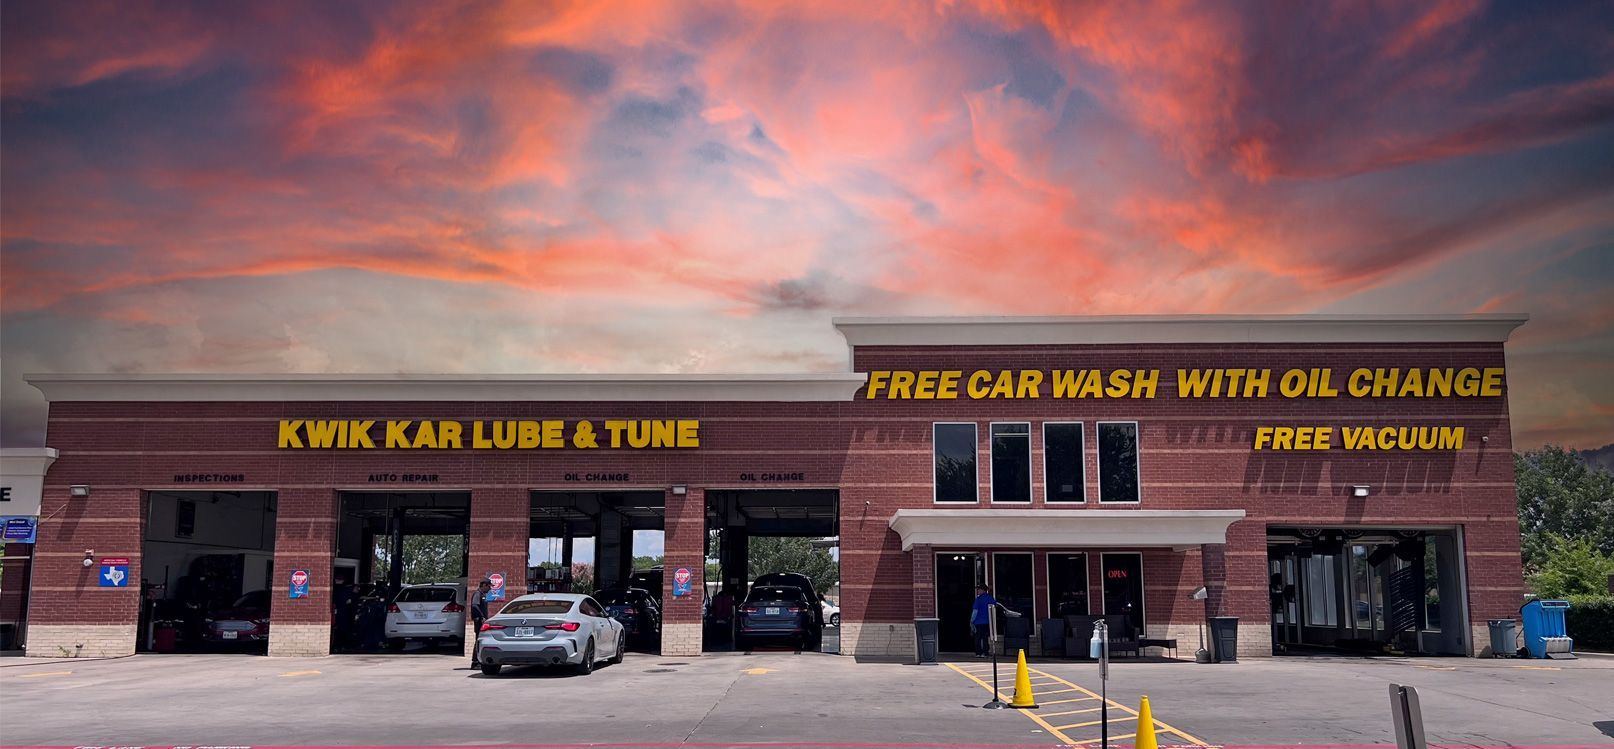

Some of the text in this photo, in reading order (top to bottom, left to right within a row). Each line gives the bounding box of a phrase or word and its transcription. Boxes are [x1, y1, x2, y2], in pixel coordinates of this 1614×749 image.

[866, 367, 1504, 400] FREE CAR WASH WITH OIL CHANGE
[278, 419, 700, 449] KWIK KAR LUBE & TUNE
[1254, 426, 1465, 450] FREE VACUUM
[173, 473, 245, 483] INSPECTIONS
[368, 473, 439, 483] AUTO REPAIR
[564, 472, 630, 482] OIL CHANGE
[739, 472, 805, 482] OIL CHANGE
[1107, 570, 1127, 578] OPEN
